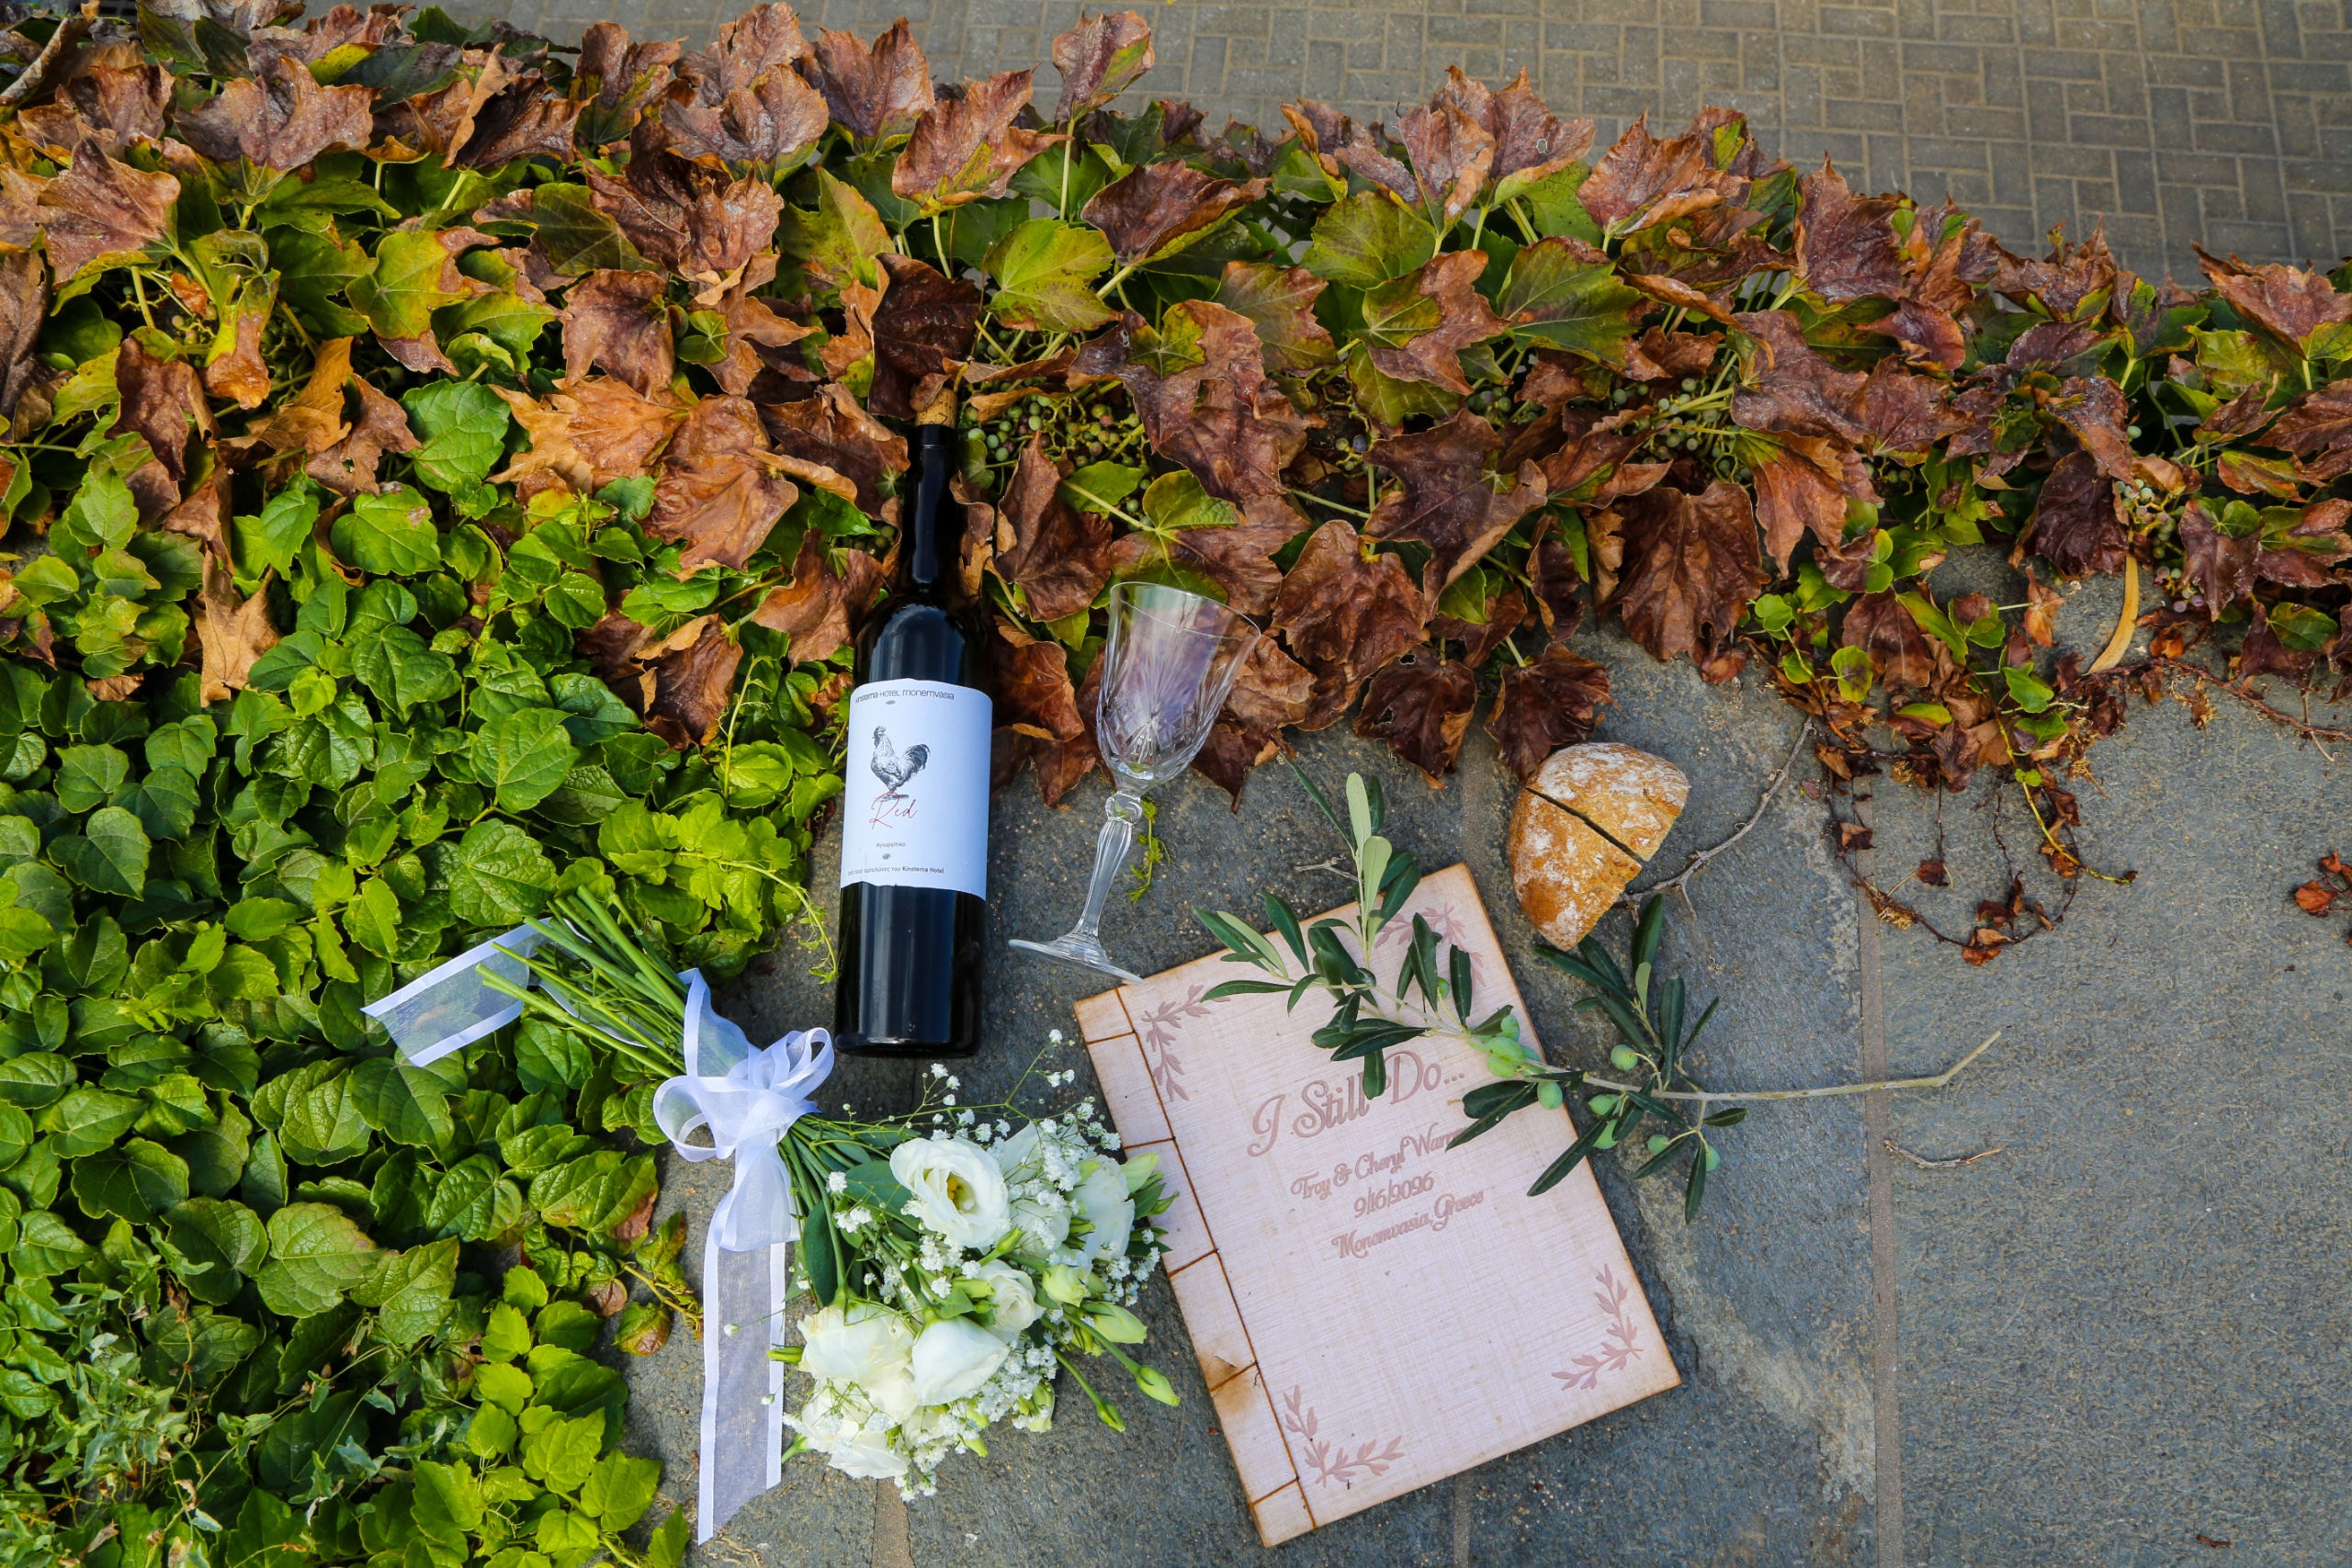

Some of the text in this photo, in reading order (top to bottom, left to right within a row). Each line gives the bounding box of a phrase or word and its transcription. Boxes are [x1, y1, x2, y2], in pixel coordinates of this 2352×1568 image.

[868, 791, 918, 829] Red
[1293, 1070, 1370, 1138] Still
[1290, 1171, 1332, 1201] Troy
[1333, 1162, 1351, 1188] &
[1354, 1144, 1406, 1174] Cheryl
[1431, 1190, 1485, 1232] Greece
